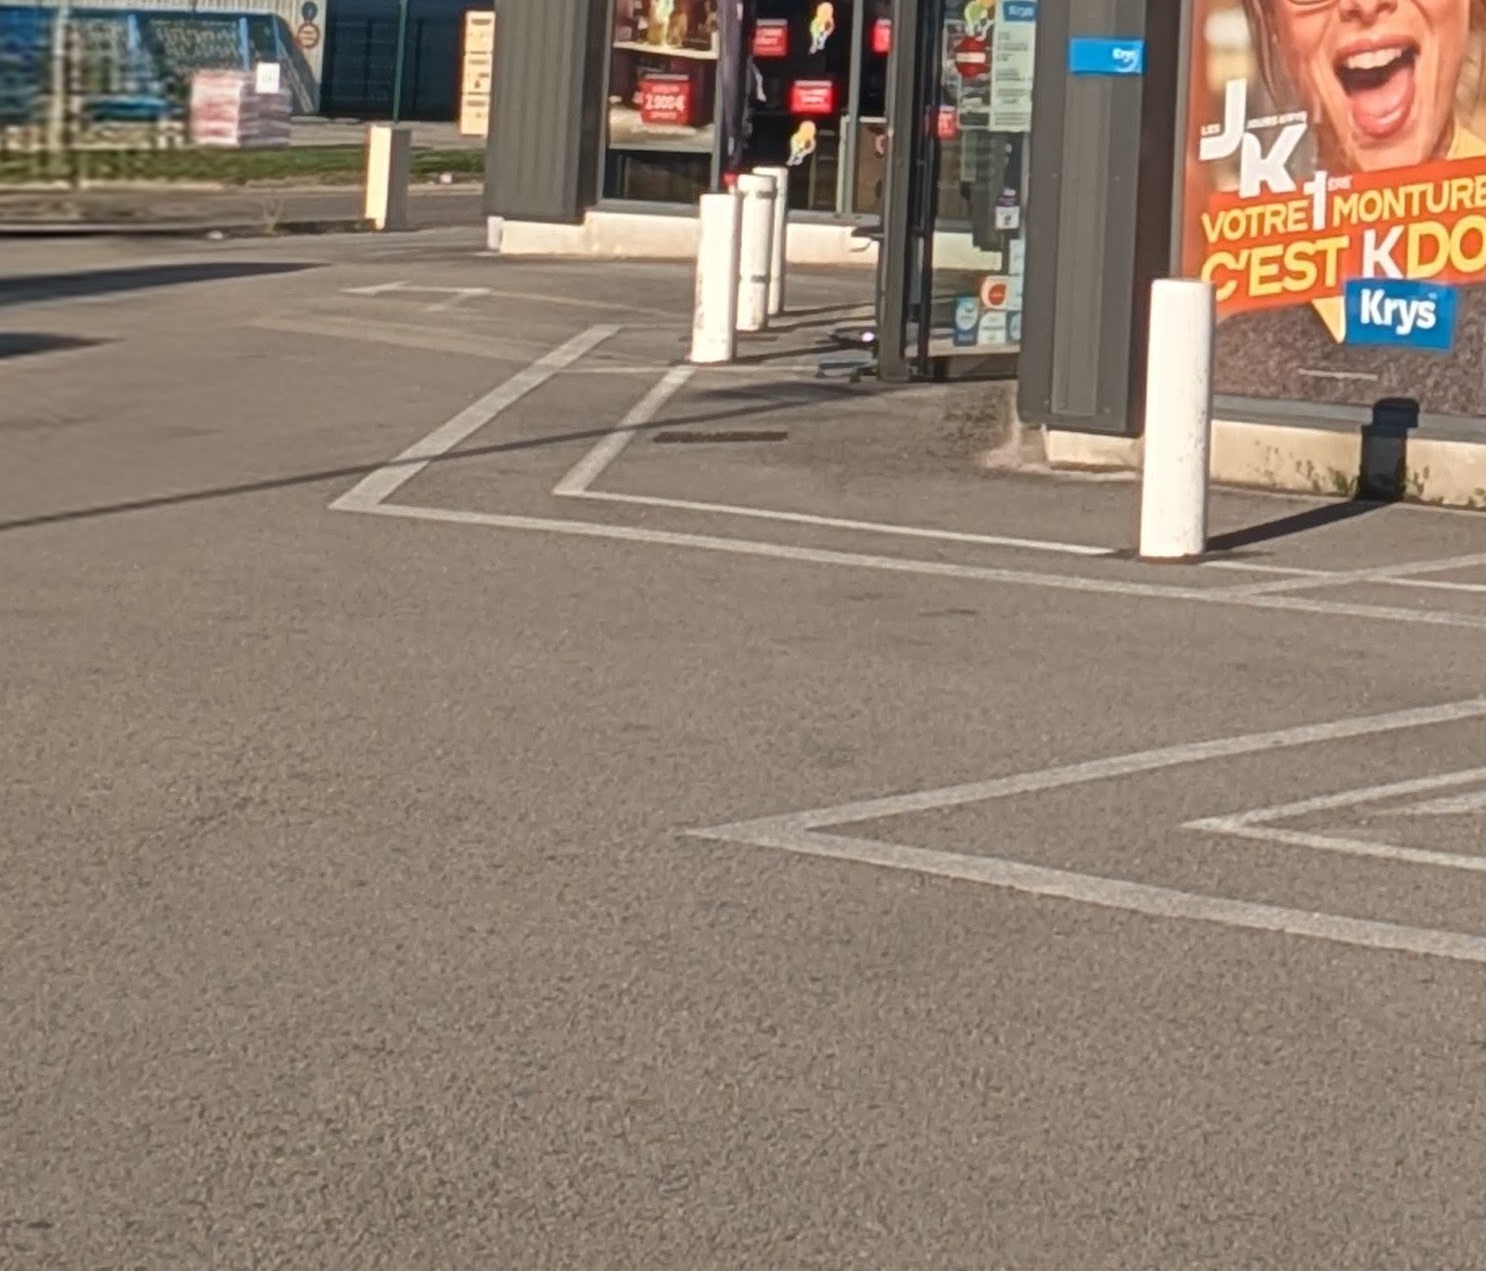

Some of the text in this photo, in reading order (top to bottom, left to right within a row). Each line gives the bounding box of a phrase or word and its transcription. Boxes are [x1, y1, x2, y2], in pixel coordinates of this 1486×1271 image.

[1202, 199, 1309, 244] VOTRE
[1201, 234, 1350, 302] C'EST
[1360, 288, 1437, 336] Krys
